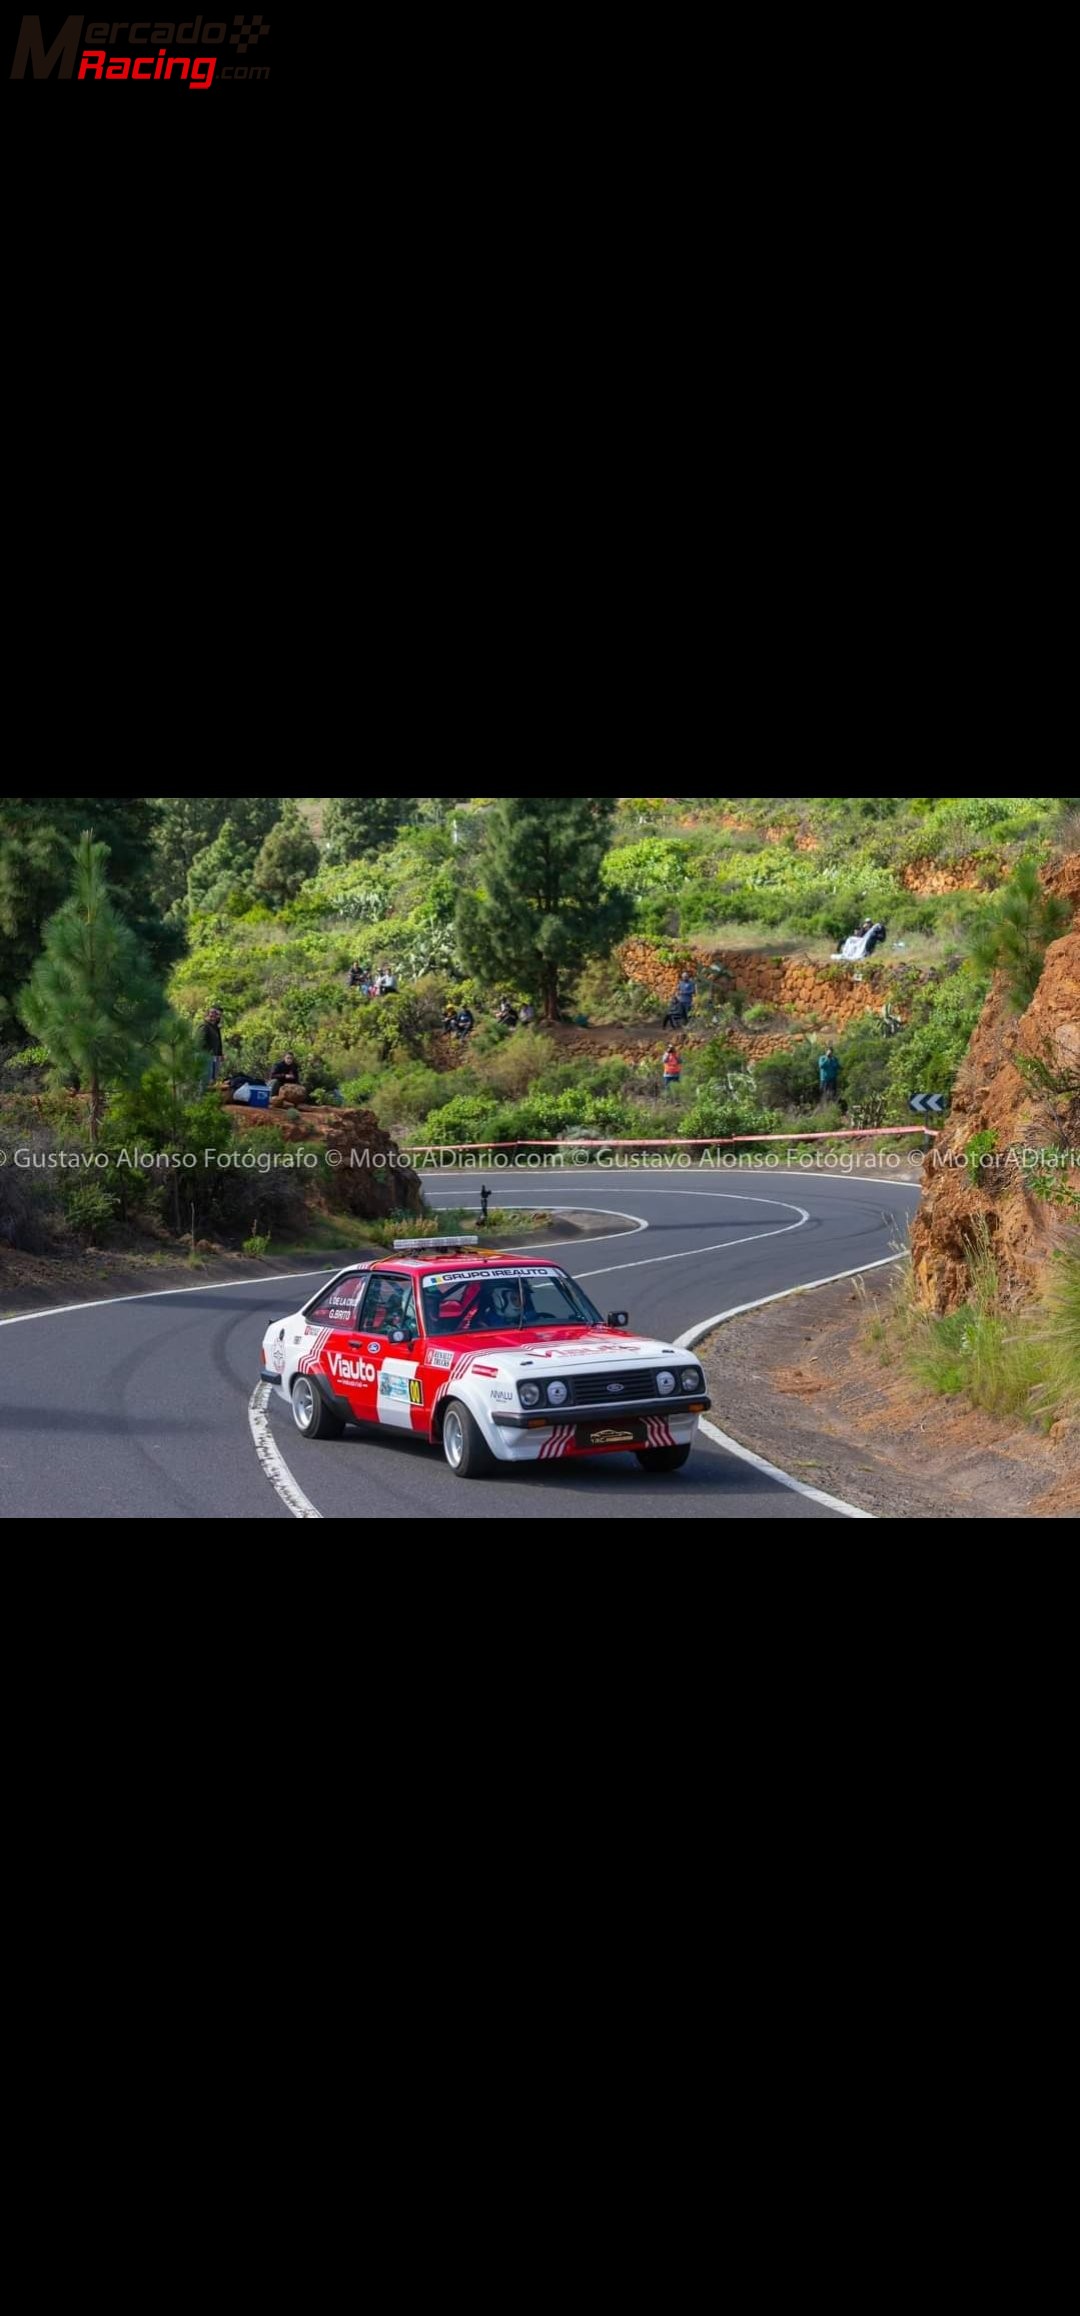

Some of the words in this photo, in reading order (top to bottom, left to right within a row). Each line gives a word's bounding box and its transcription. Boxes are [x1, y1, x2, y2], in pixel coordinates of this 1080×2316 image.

[442, 1271, 491, 1281] GRUPO
[492, 1268, 548, 1277] IREAUTO
[327, 1352, 376, 1382] Viauto
